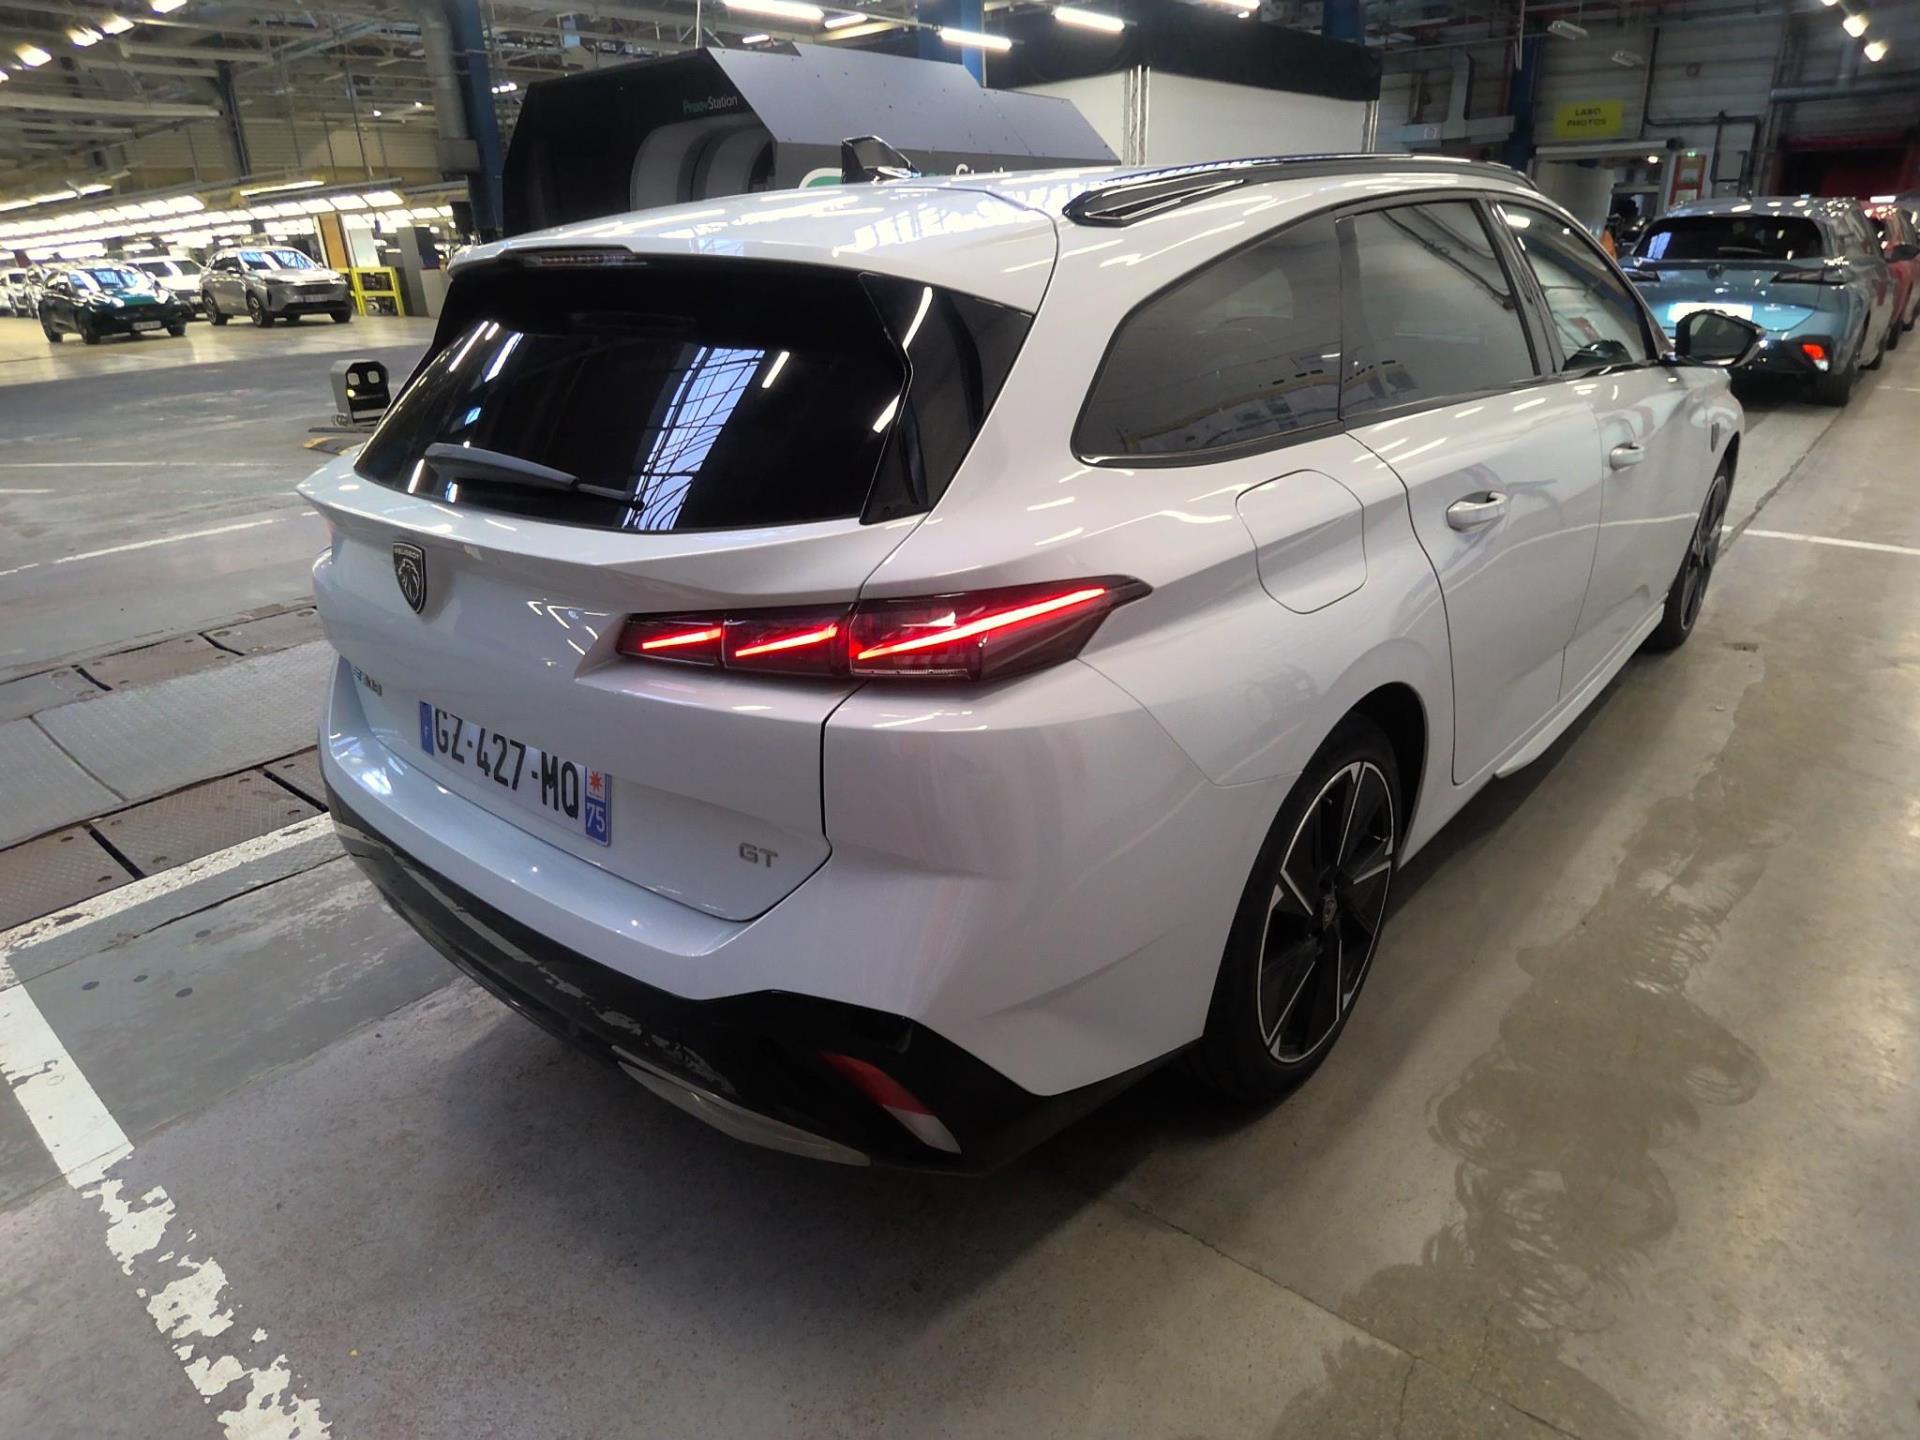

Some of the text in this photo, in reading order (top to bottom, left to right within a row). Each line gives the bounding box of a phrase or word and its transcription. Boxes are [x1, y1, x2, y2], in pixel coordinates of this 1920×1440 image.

[1566, 118, 1607, 128] PHOTOS
[435, 708, 579, 820] GZ-427-MQ
[587, 804, 606, 833] 75
[739, 842, 779, 868] GT
